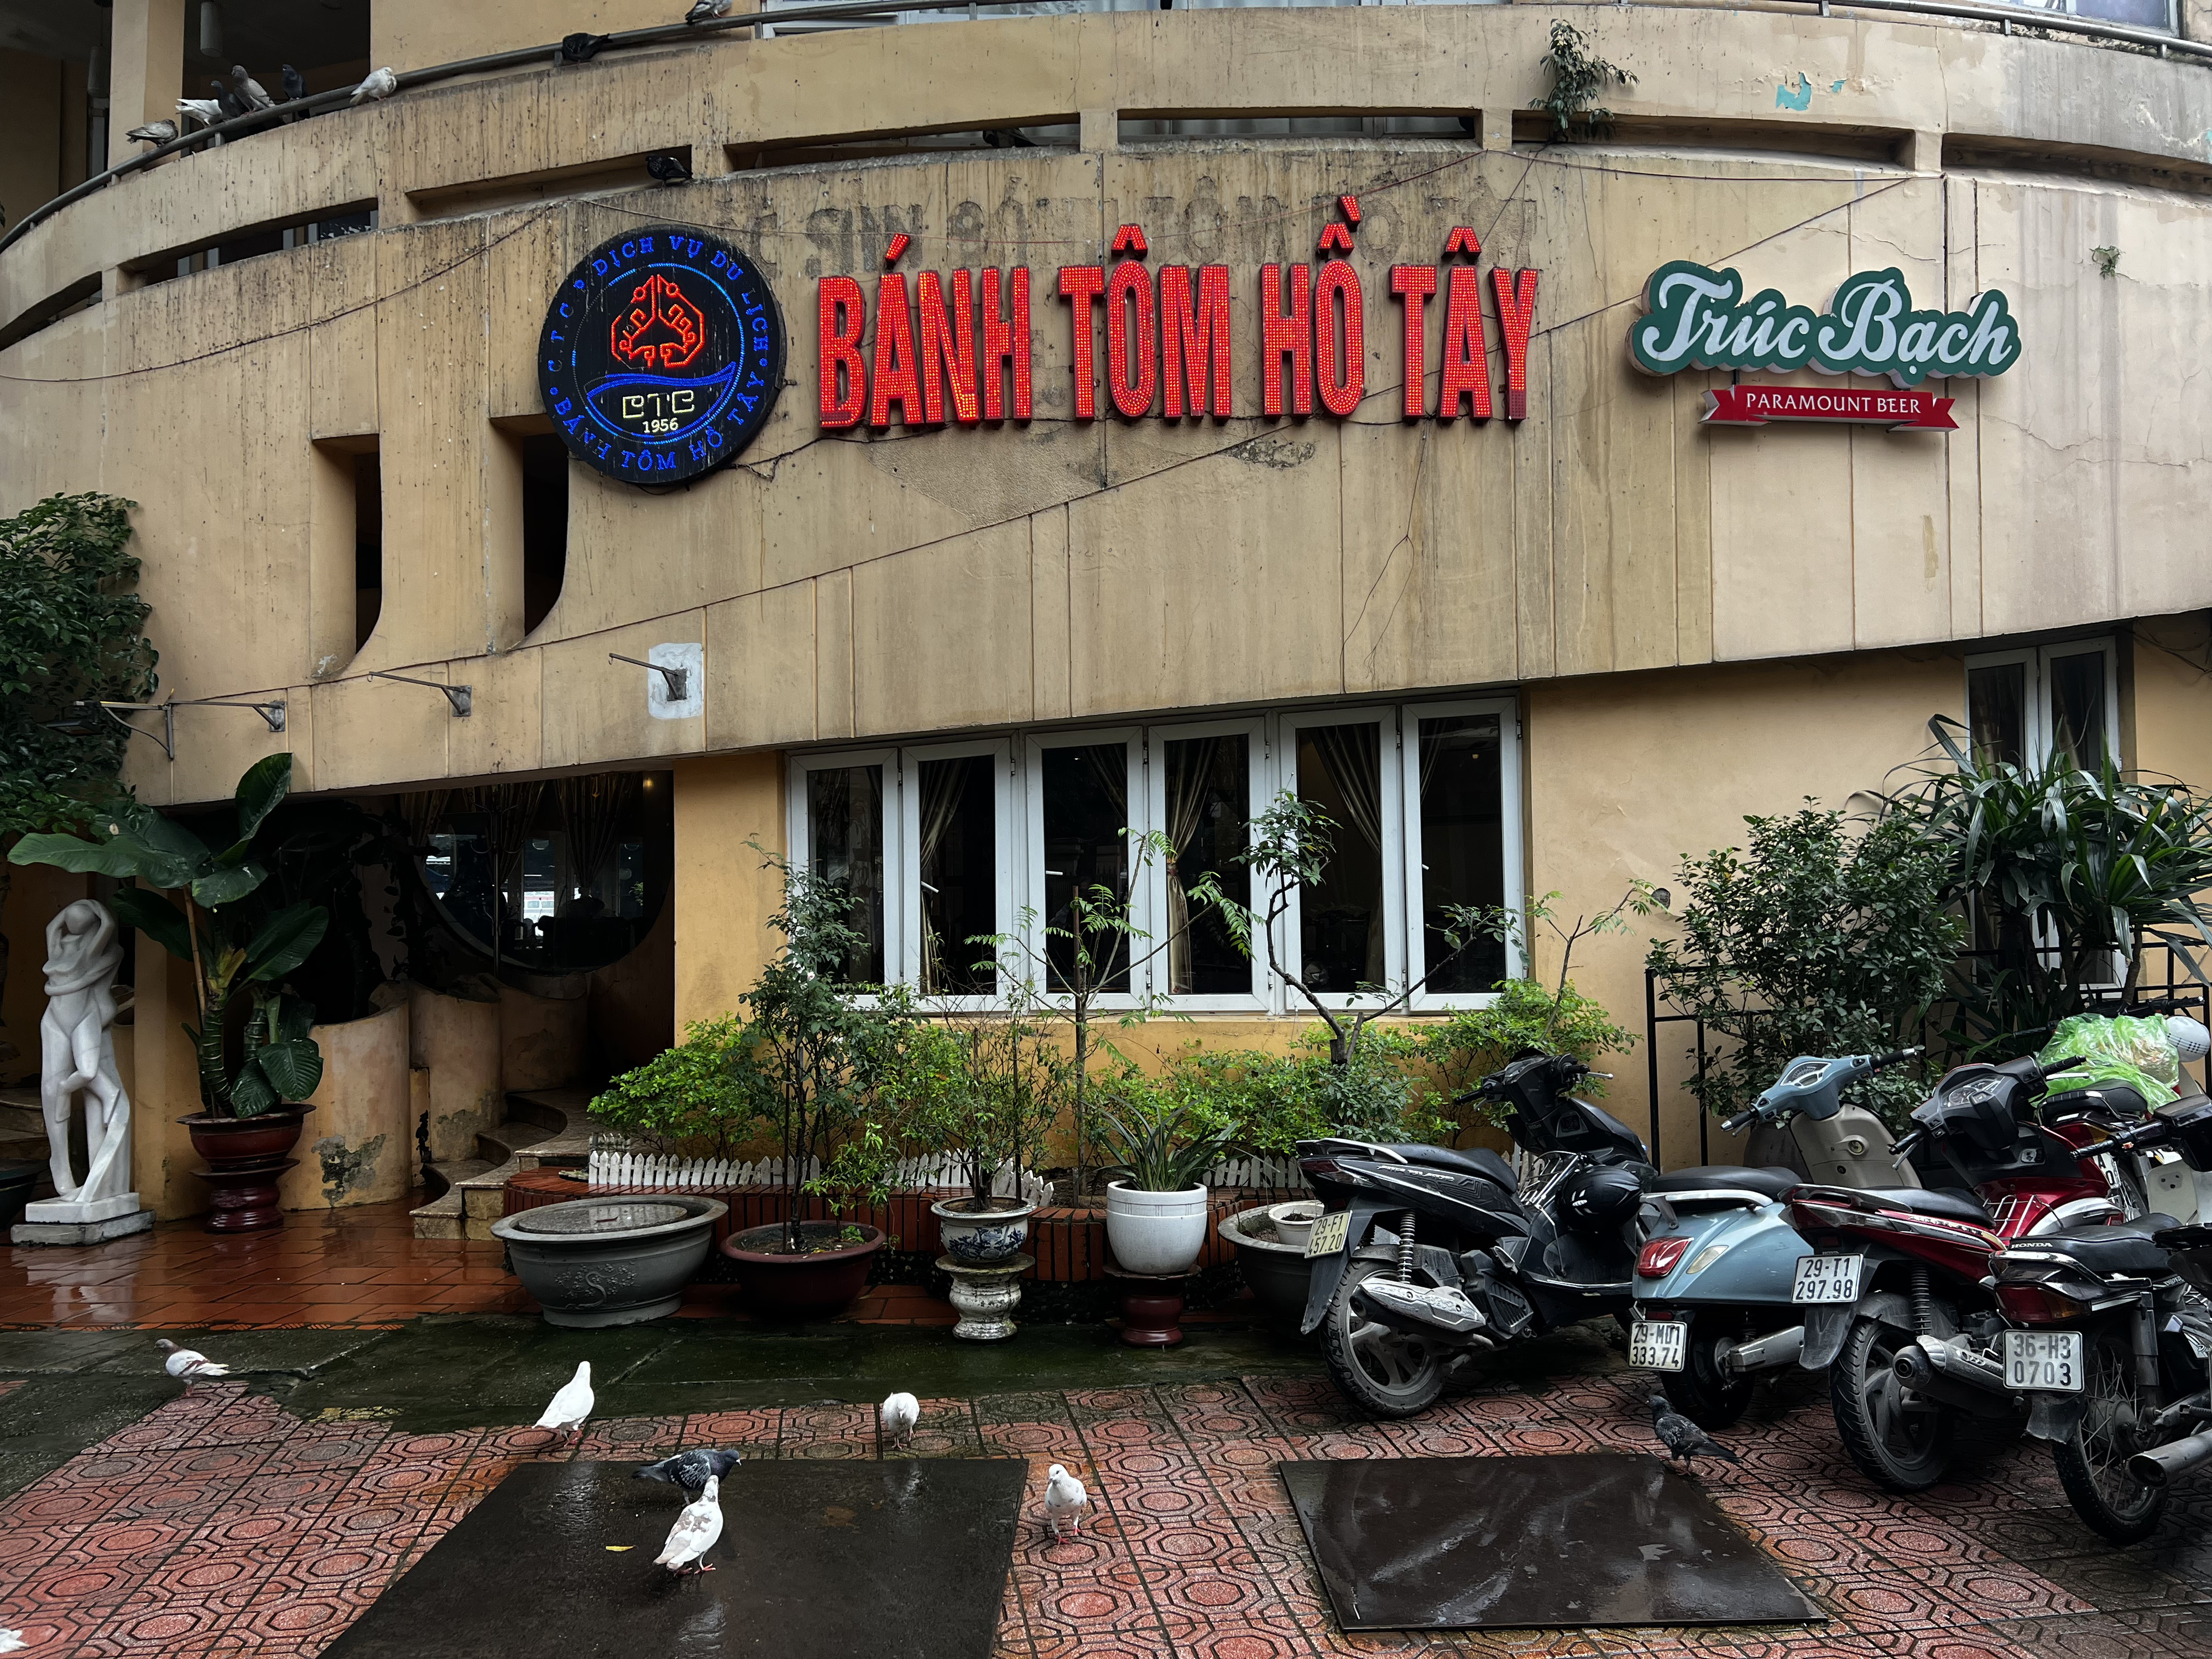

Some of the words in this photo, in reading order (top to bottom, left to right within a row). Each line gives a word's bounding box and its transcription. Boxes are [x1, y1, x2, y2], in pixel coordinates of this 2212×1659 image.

[711, 250, 744, 280] DU
[818, 232, 1032, 430] BÁNH
[1059, 223, 1232, 425] TÔM
[1260, 195, 1365, 423] HỒ
[1389, 226, 1540, 423] TÂY
[1642, 272, 1811, 362] Trúc
[1818, 278, 2013, 374] Bạch
[1746, 393, 1871, 413] PARAMOUNT
[1877, 397, 1921, 414] BEER
[641, 417, 679, 434] 1956
[1314, 1214, 1344, 1236] 29-F1
[1308, 1233, 1343, 1255] 457.20
[1803, 1258, 1850, 1278] 29-T1
[1796, 1279, 1853, 1300] 297.98
[1631, 1345, 1679, 1368] 333.74
[2013, 1334, 2071, 1359] 36-H3
[2014, 1360, 2072, 1386] 0703
